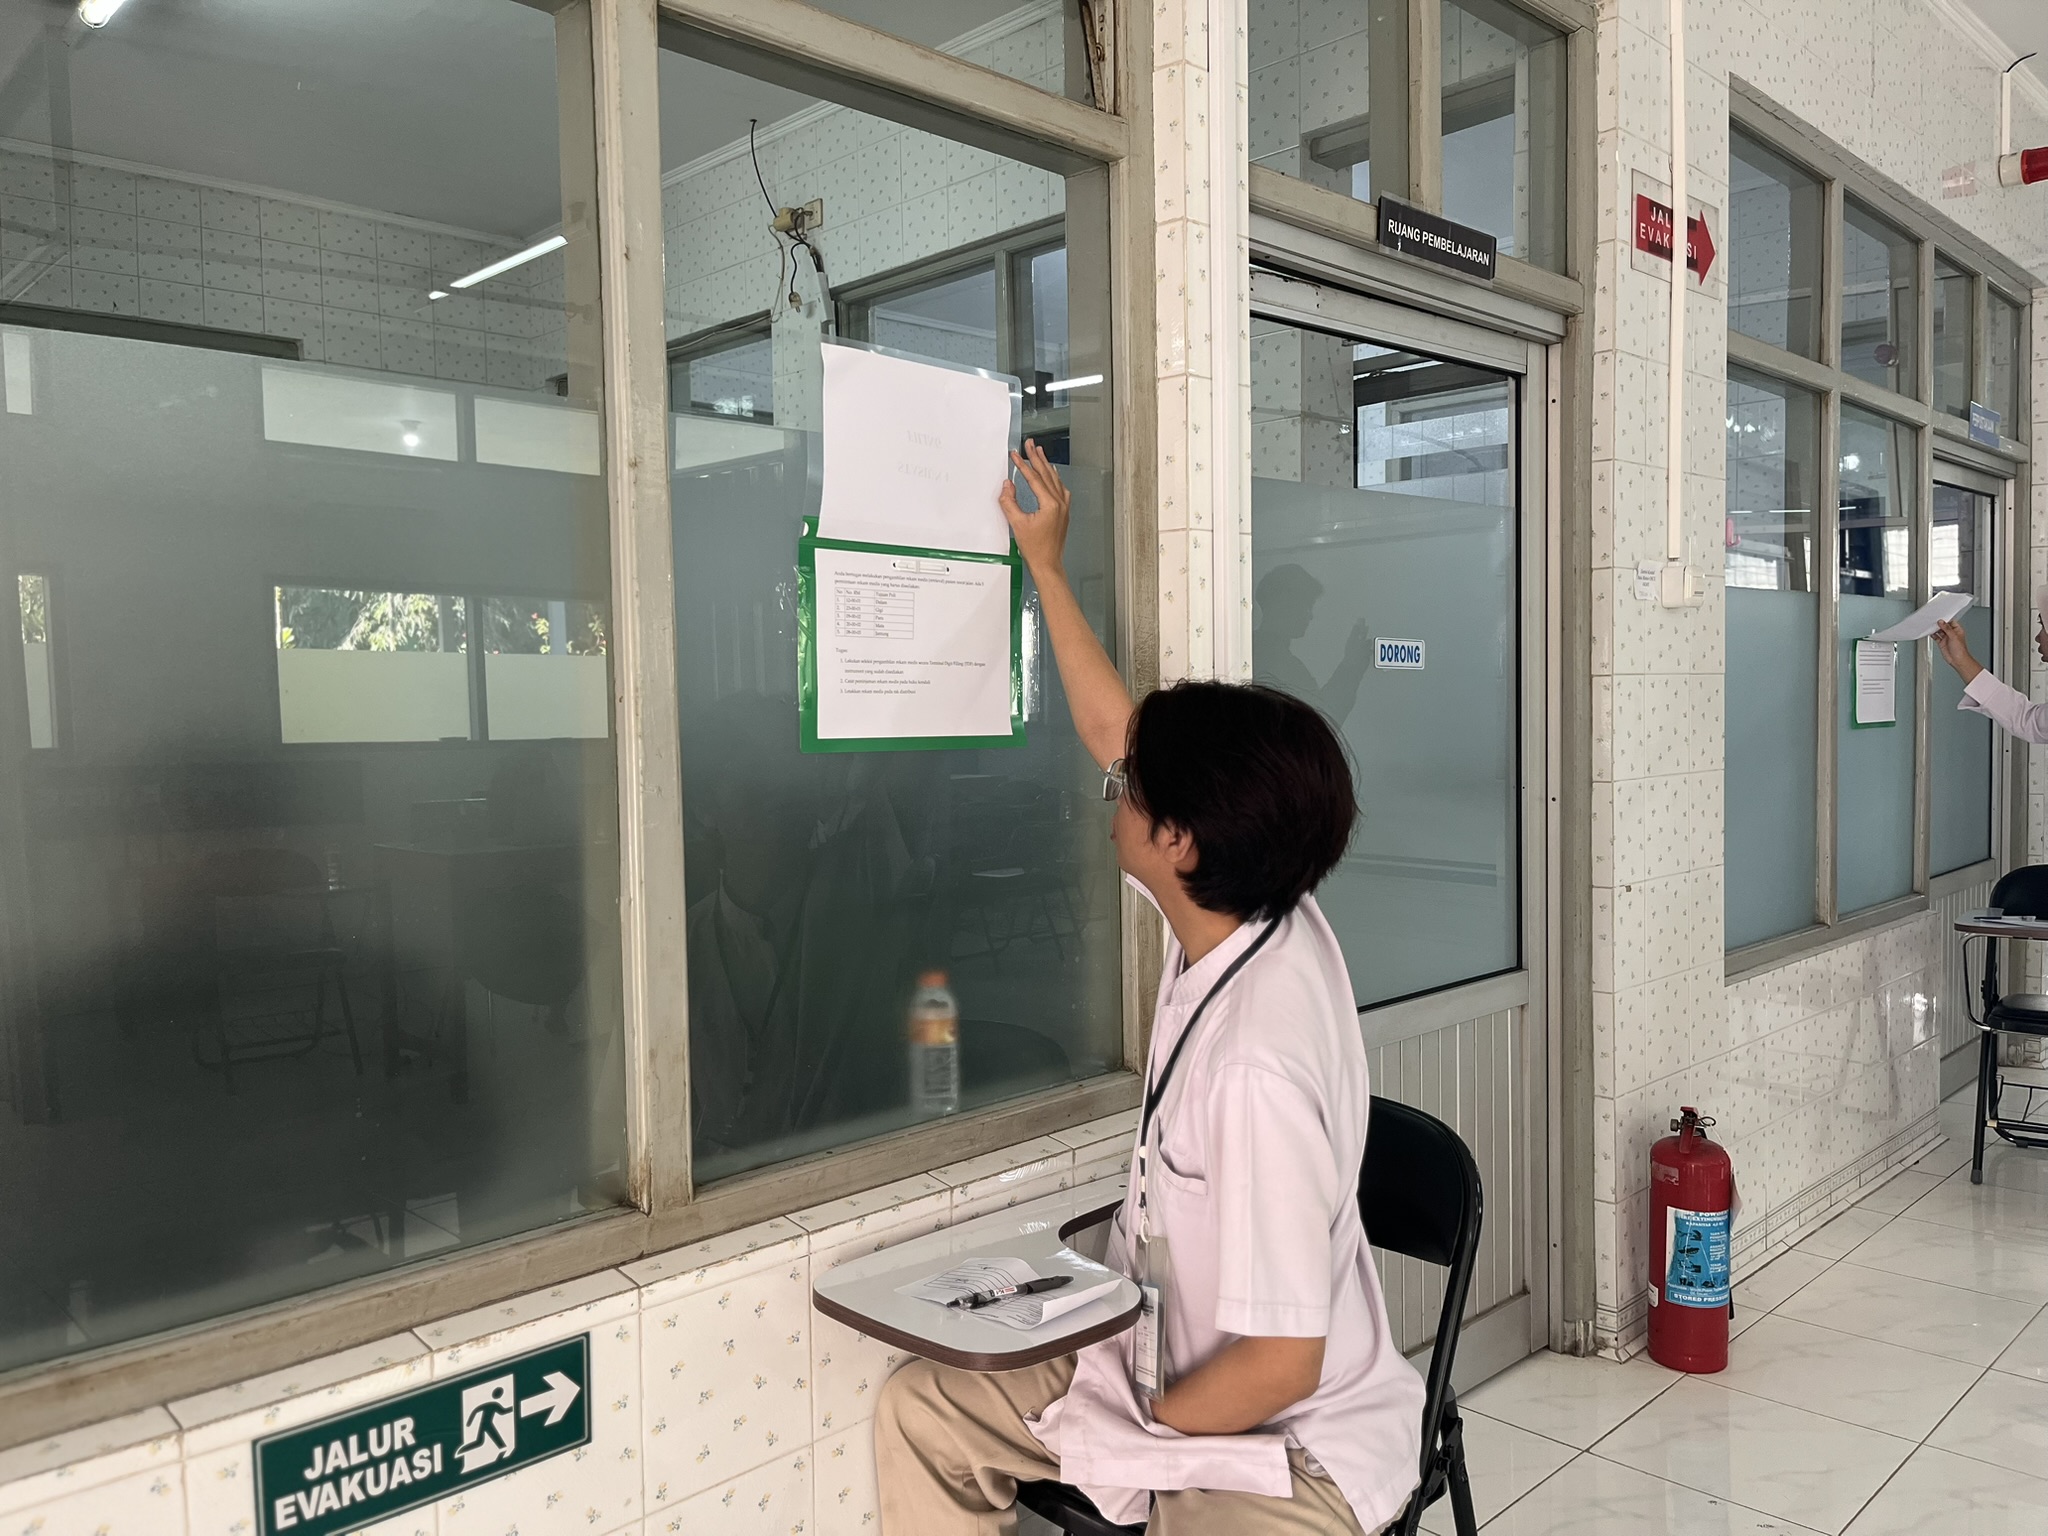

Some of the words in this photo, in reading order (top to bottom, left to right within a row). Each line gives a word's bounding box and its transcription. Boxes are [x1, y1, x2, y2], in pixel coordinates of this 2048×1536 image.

[1650, 206, 1671, 229] JAL
[1388, 219, 1420, 242] RUANG
[1422, 231, 1490, 266] PEMBELAJARAN
[1640, 222, 1697, 260] EVAKSI
[1380, 644, 1420, 664] DORONG
[1674, 1293, 1702, 1301] STORED
[304, 1417, 415, 1480] JALUR
[274, 1444, 442, 1530] EVAKUASI
